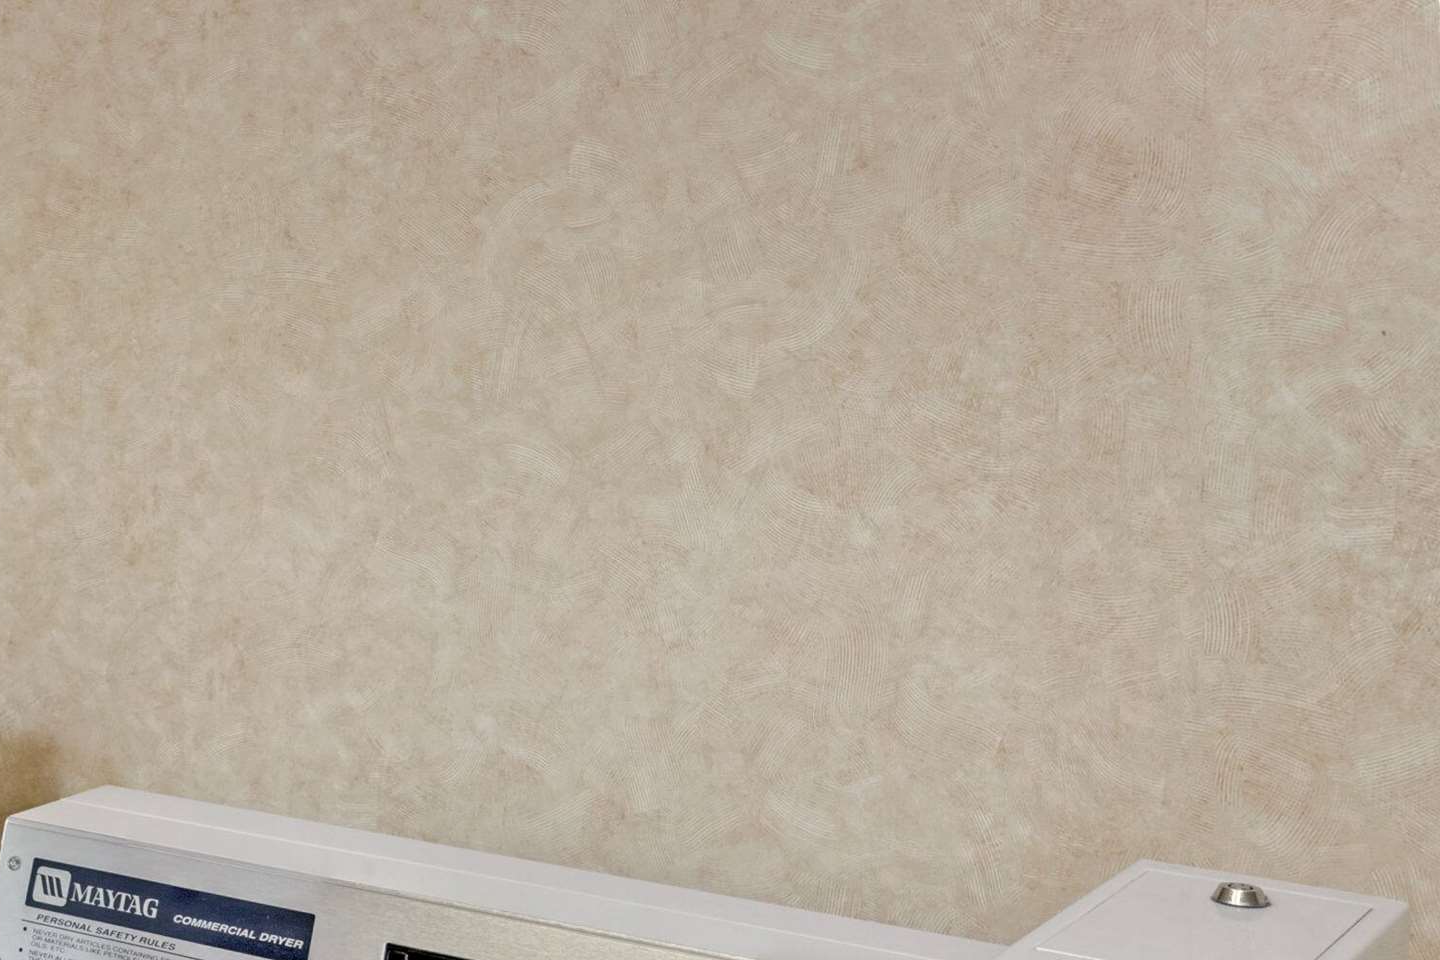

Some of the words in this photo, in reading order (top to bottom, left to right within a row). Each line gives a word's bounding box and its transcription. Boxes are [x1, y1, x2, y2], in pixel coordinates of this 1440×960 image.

[36, 914, 92, 932] PERSONAL
[96, 926, 138, 944] SAFETY
[139, 936, 176, 950] RULES
[70, 882, 159, 918] MAYTAG
[172, 914, 256, 940] COMMERCIAL
[259, 932, 304, 950] DRYER
